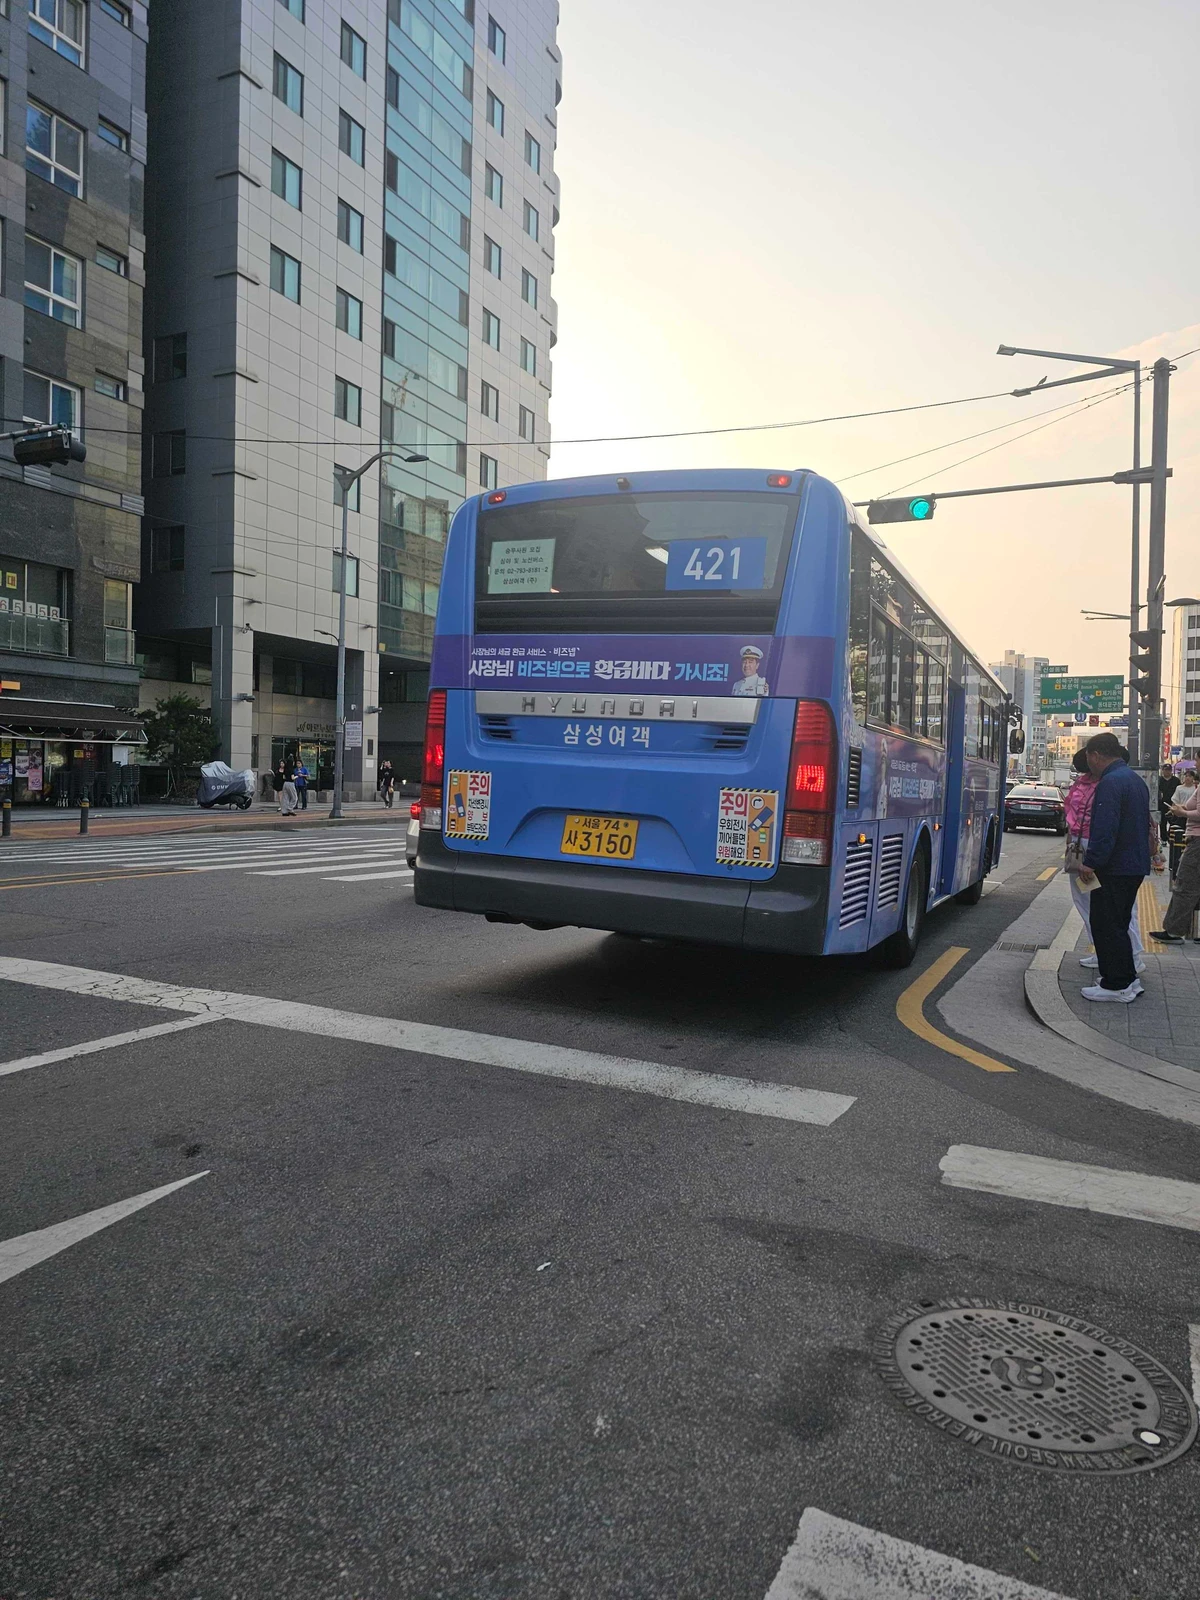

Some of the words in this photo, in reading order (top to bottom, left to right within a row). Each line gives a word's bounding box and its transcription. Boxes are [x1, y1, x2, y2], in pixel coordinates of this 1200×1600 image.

[684, 547, 740, 580] 421
[472, 648, 497, 656] 사장님의
[498, 648, 511, 656] 세금
[512, 648, 525, 656] 환급
[527, 648, 547, 656] 서비스
[468, 660, 514, 677] 사장님!
[518, 660, 591, 678] 비즈넵으로
[594, 659, 672, 680] 환급바다
[675, 663, 729, 682] 가시죠!
[521, 697, 698, 718] HYUNDAI
[563, 723, 651, 748] 삼성여객
[469, 774, 490, 796] 주의
[720, 792, 748, 816] 주의
[582, 818, 600, 829] 서울
[603, 820, 620, 831] 74
[719, 818, 746, 831] 우회전시
[718, 832, 746, 845] 끼어들면
[1000, 1300, 1051, 1321] SEOUL
[1056, 1315, 1173, 1387] METROPOLITAN
[988, 1436, 1058, 1467] SEOUL
